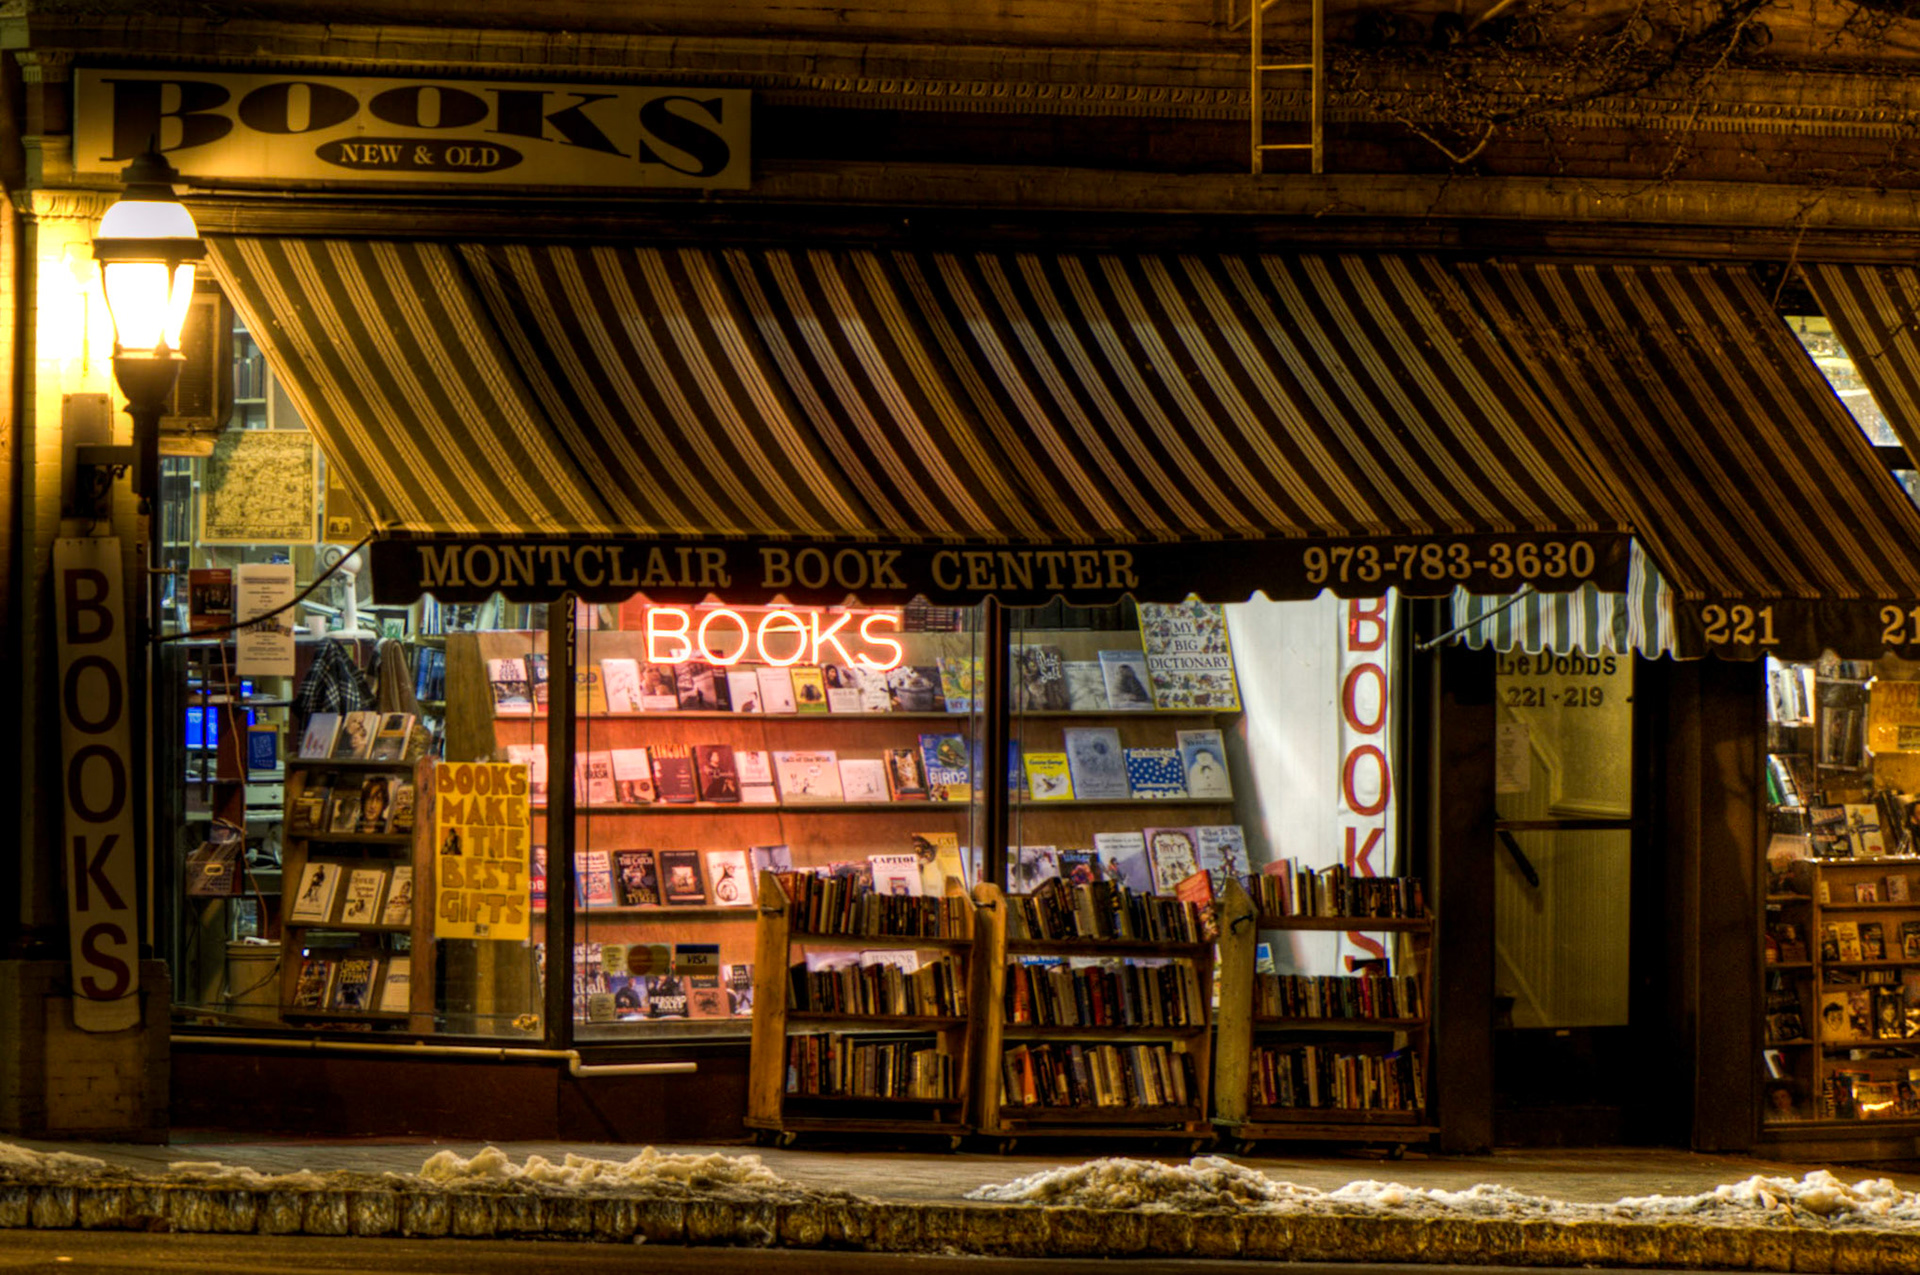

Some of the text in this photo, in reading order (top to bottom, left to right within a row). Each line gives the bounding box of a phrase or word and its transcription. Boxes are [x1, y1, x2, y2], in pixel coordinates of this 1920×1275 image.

[100, 78, 731, 178] BOOKS
[340, 142, 501, 167] NEW & OLD
[417, 544, 1139, 590] MONTCLAIR BOOK CENTER
[1303, 540, 1596, 584] 973-783-3630
[646, 607, 903, 671] BOOKS
[1173, 621, 1193, 633] MY
[1701, 604, 1780, 645] 221
[1149, 656, 1230, 669] DICTIONARY
[1174, 640, 1199, 651] BIG
[63, 568, 131, 1001] BOOKS
[437, 763, 527, 796] BOOKS
[442, 795, 525, 828] MAKE
[467, 826, 525, 860] THE
[441, 857, 524, 891] BEST
[439, 890, 525, 925] GIFTS
[687, 955, 708, 964] VISA
